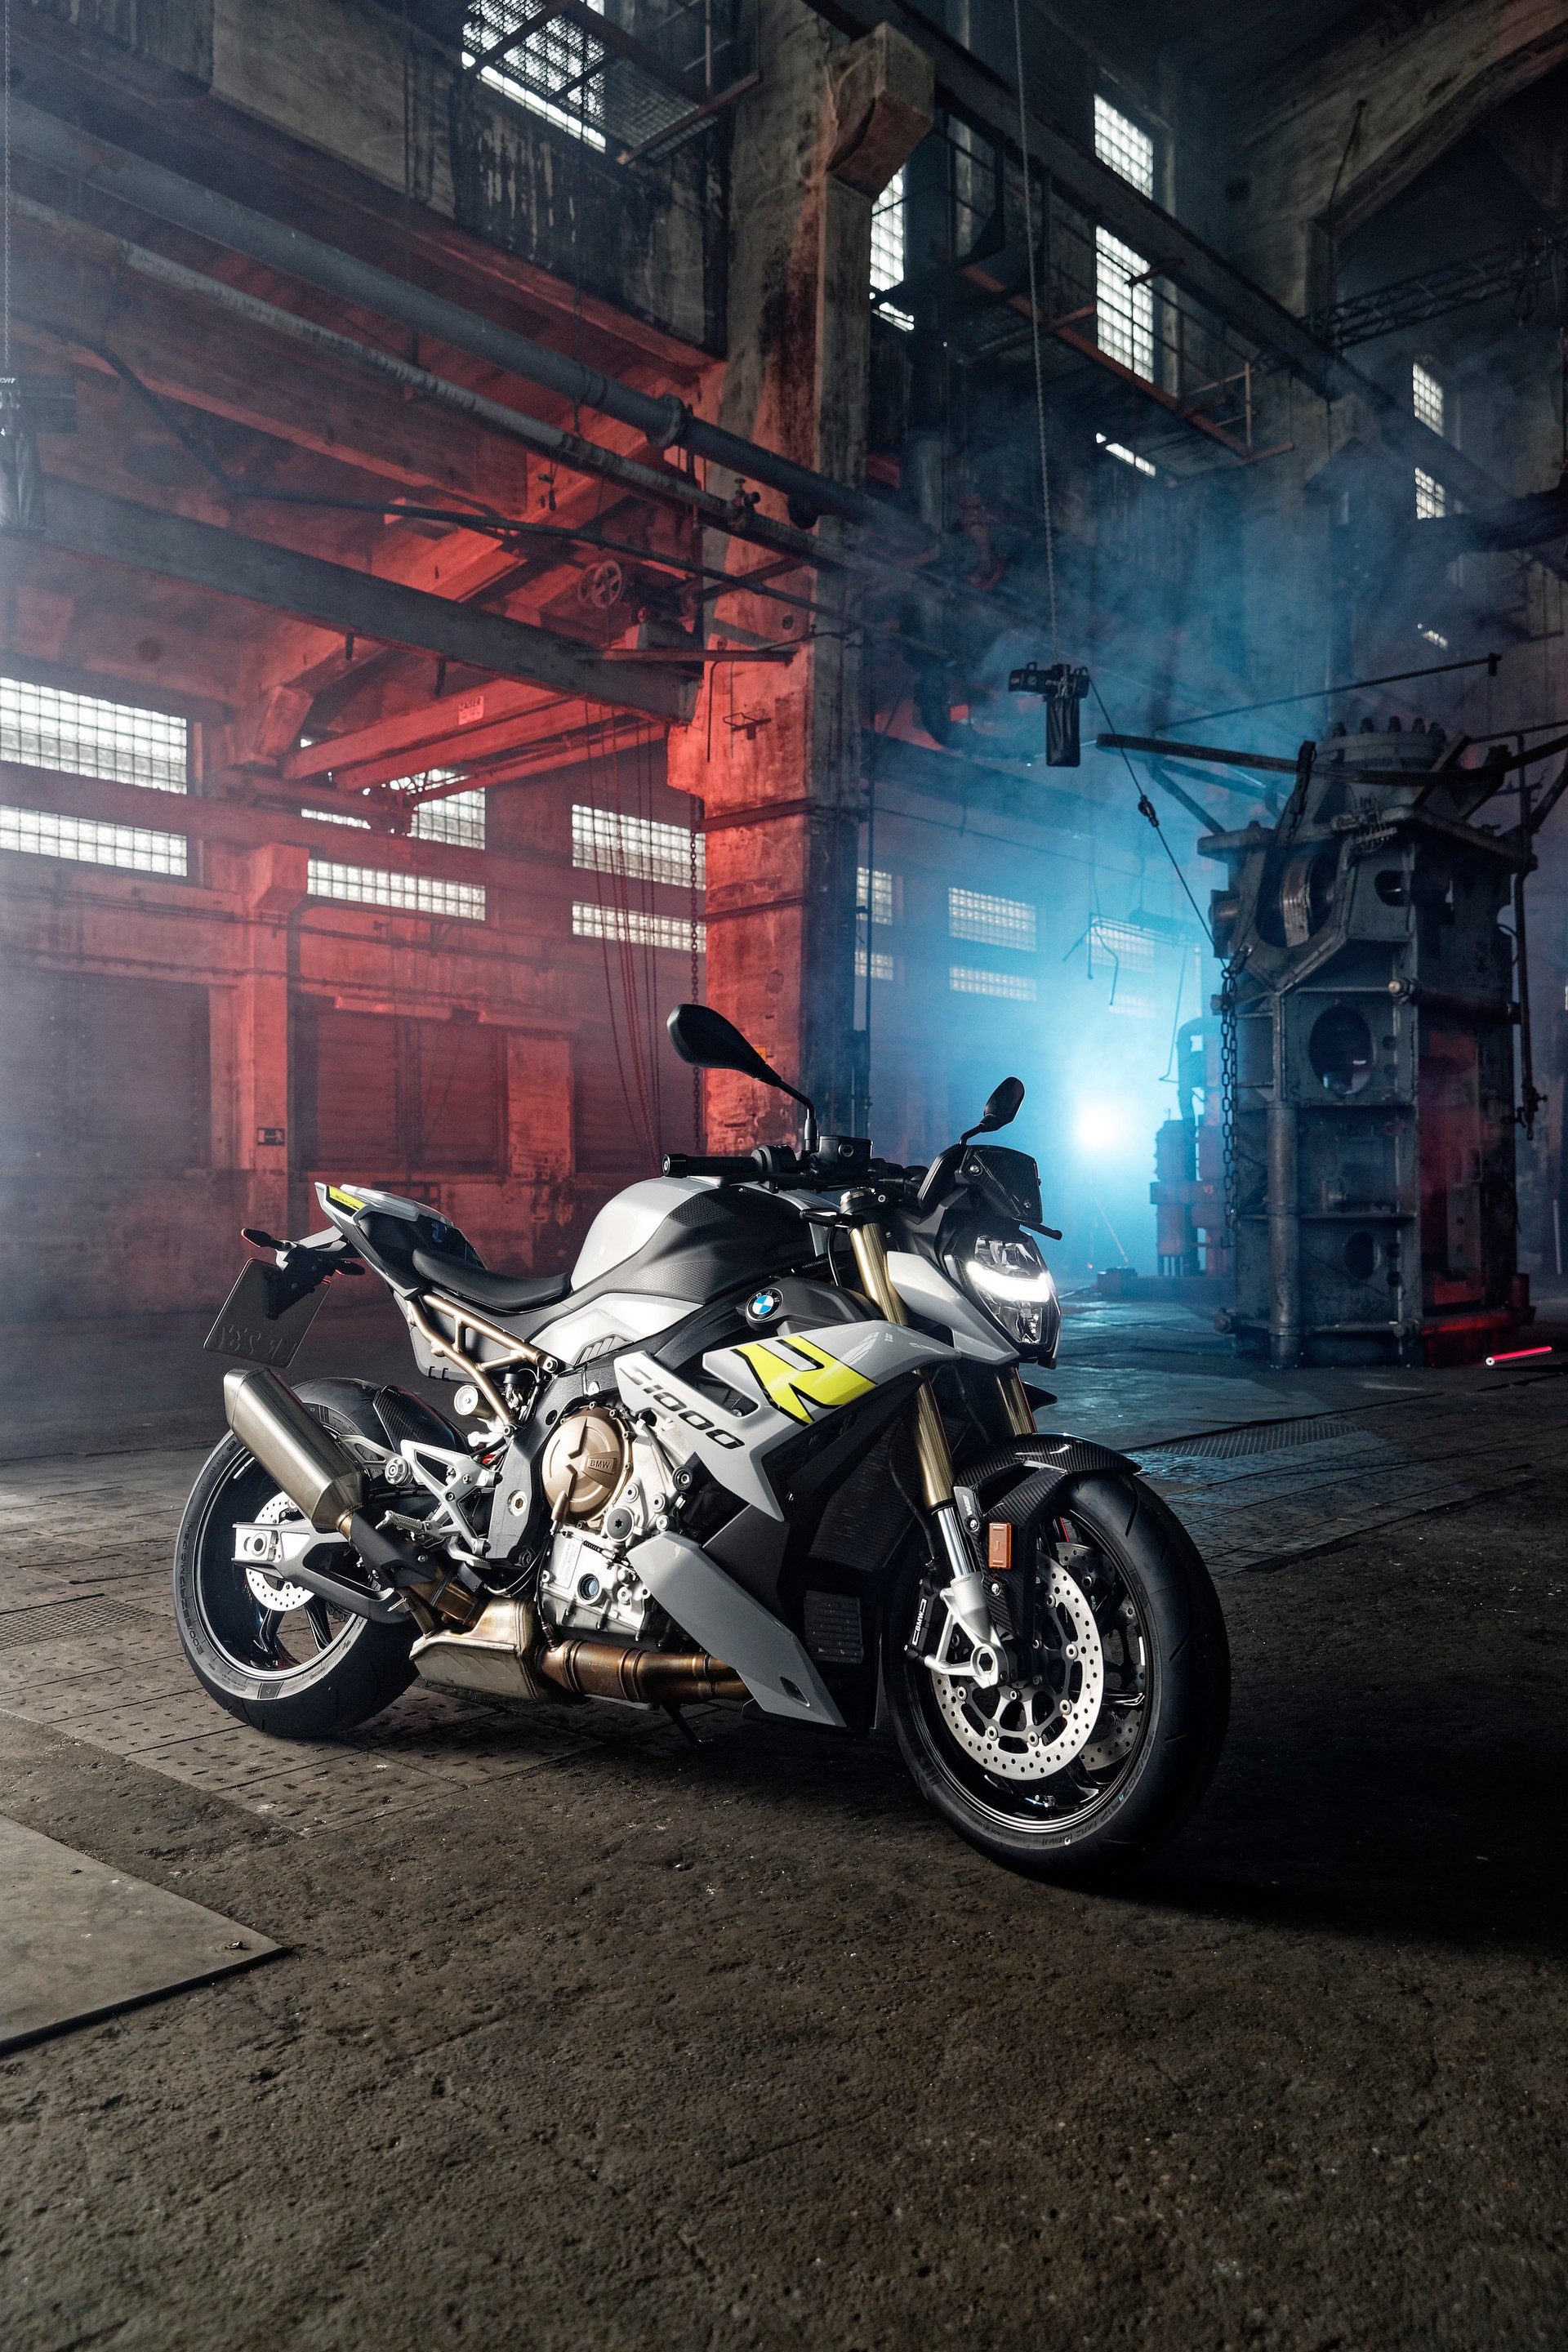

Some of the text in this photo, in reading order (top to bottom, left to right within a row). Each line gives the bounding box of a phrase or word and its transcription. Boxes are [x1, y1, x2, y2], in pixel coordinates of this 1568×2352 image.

[755, 1290, 780, 1303] BMW
[619, 1365, 746, 1450] S1000
[590, 1460, 611, 1468] BMW
[915, 1610, 924, 1632] BMW
